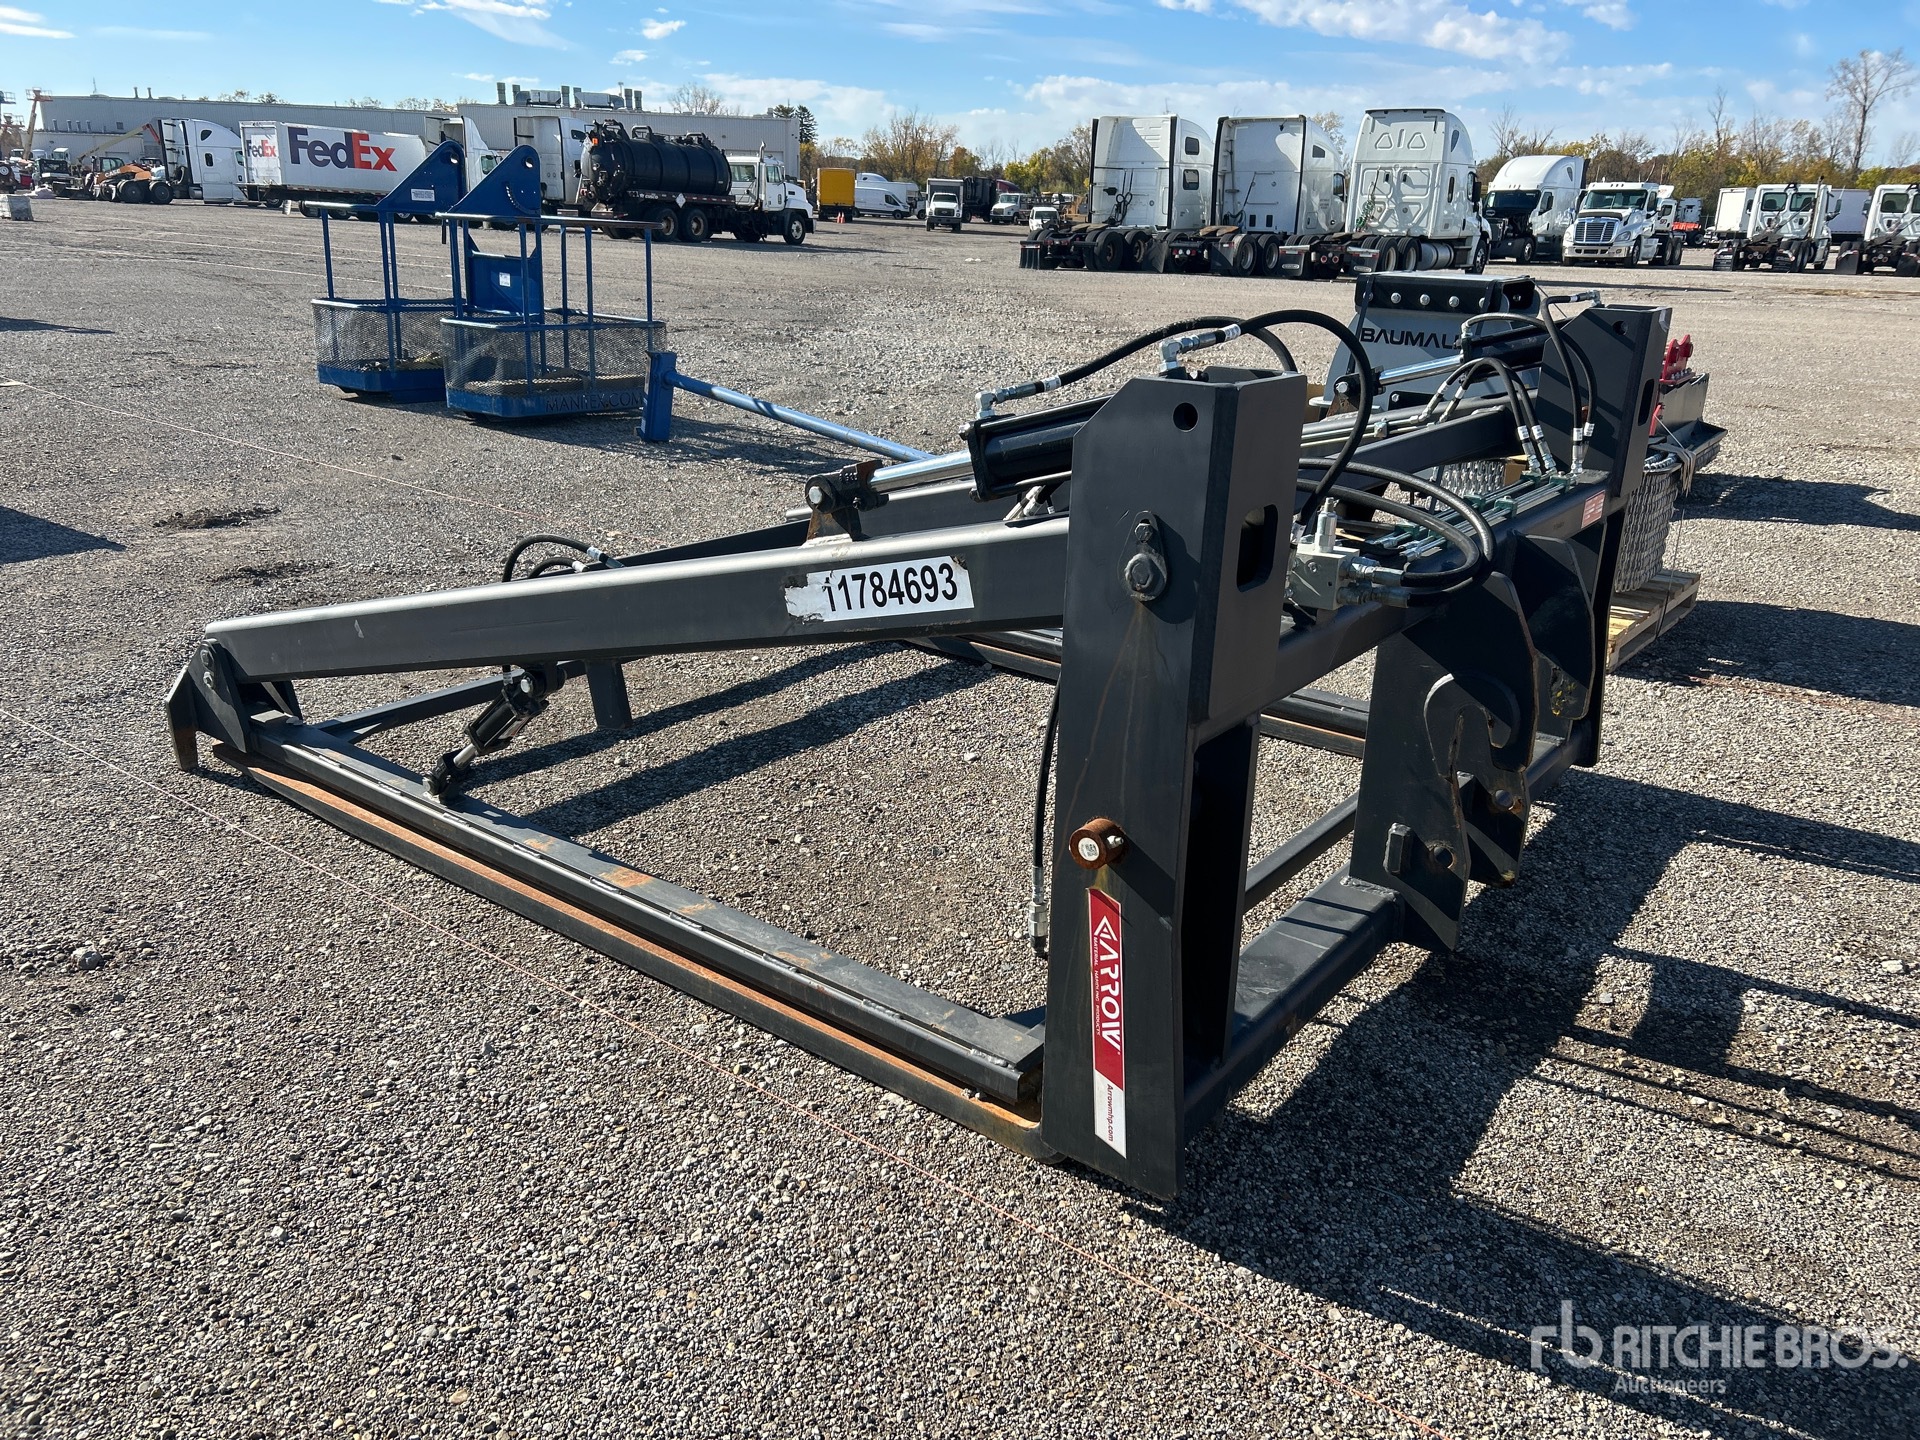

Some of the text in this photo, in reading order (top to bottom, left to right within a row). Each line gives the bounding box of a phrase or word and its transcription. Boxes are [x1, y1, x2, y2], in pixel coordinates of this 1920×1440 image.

[246, 139, 277, 157] FedEx
[287, 127, 398, 171] FedEx
[1360, 328, 1462, 350] BAUMAL
[545, 391, 644, 413] MANITEX.COM
[822, 562, 958, 612] 11784693
[1099, 938, 1121, 1052] ARROW
[1106, 1083, 1114, 1142] Arrowmhp.com
